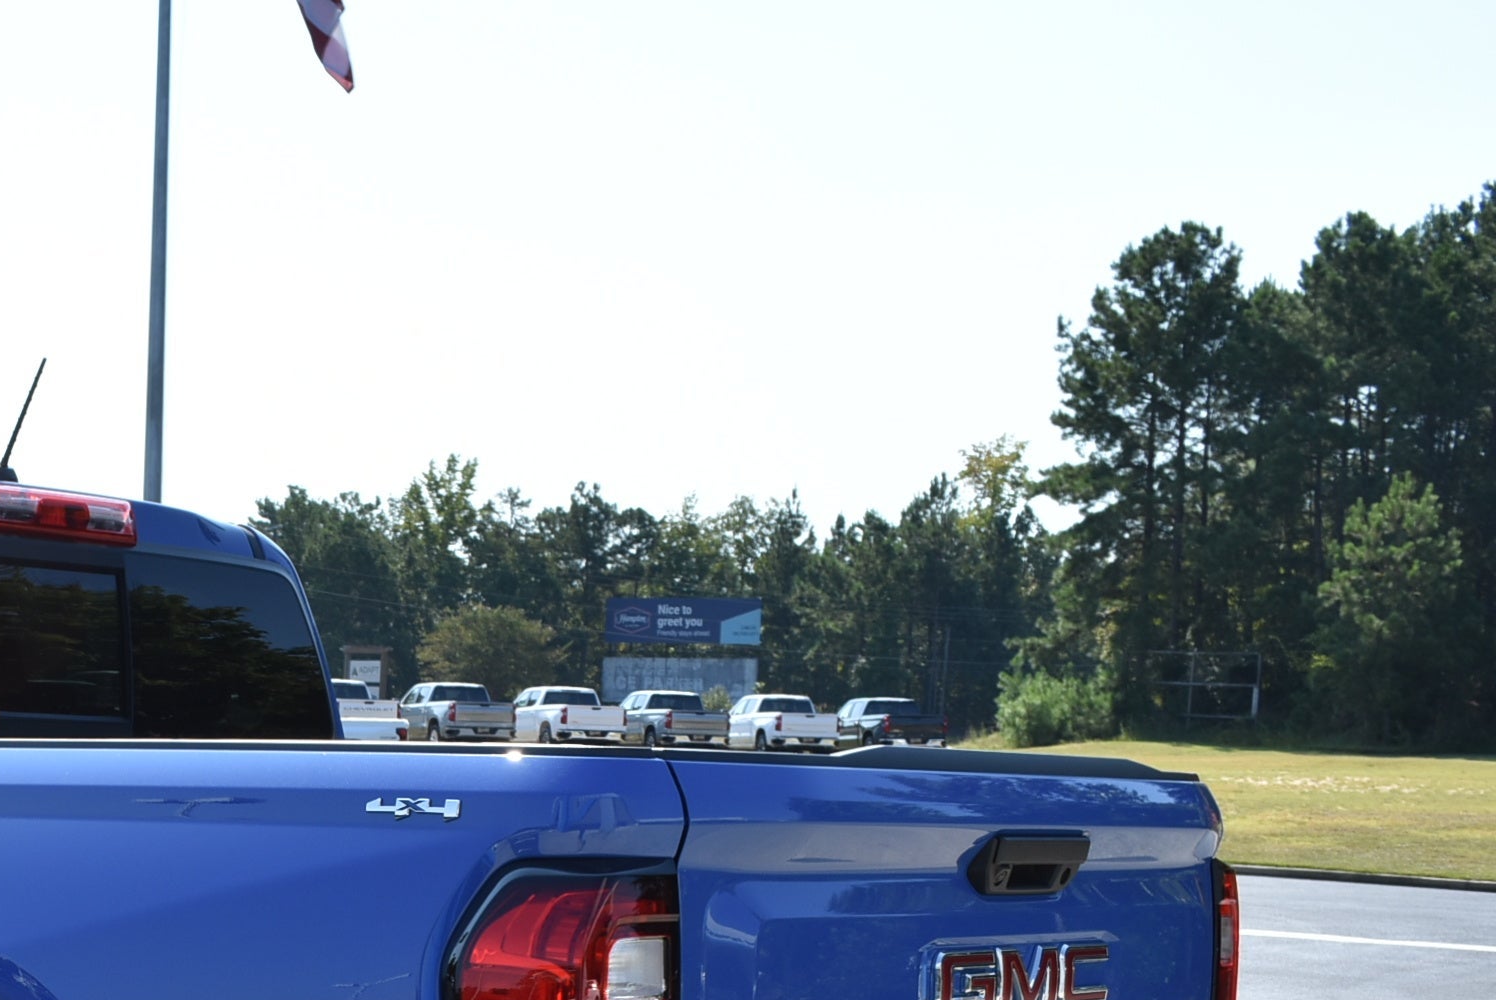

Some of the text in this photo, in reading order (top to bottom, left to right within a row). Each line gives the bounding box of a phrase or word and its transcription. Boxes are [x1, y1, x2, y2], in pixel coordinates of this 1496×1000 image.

[657, 604, 693, 615] Nice to
[657, 617, 704, 629] greet you
